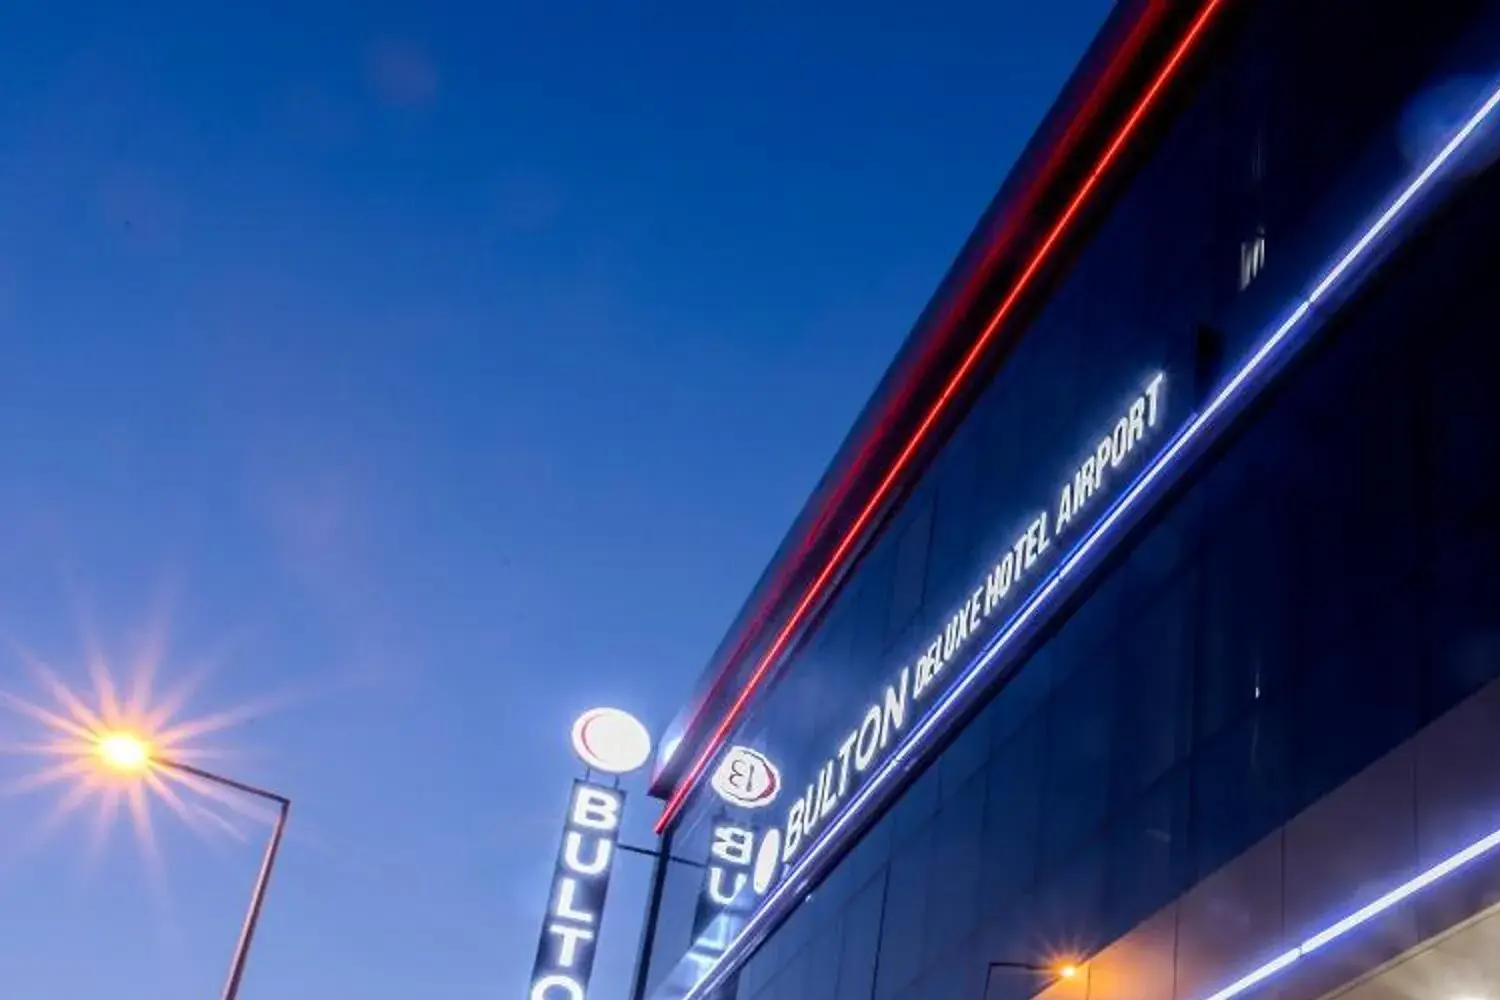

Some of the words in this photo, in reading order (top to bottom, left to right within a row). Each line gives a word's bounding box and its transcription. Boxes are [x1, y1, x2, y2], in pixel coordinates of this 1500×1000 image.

[782, 667, 909, 862] BULTON
[913, 585, 984, 699] DELUXE
[984, 511, 1051, 617] HOTEL
[1056, 372, 1163, 535] AIRPORT
